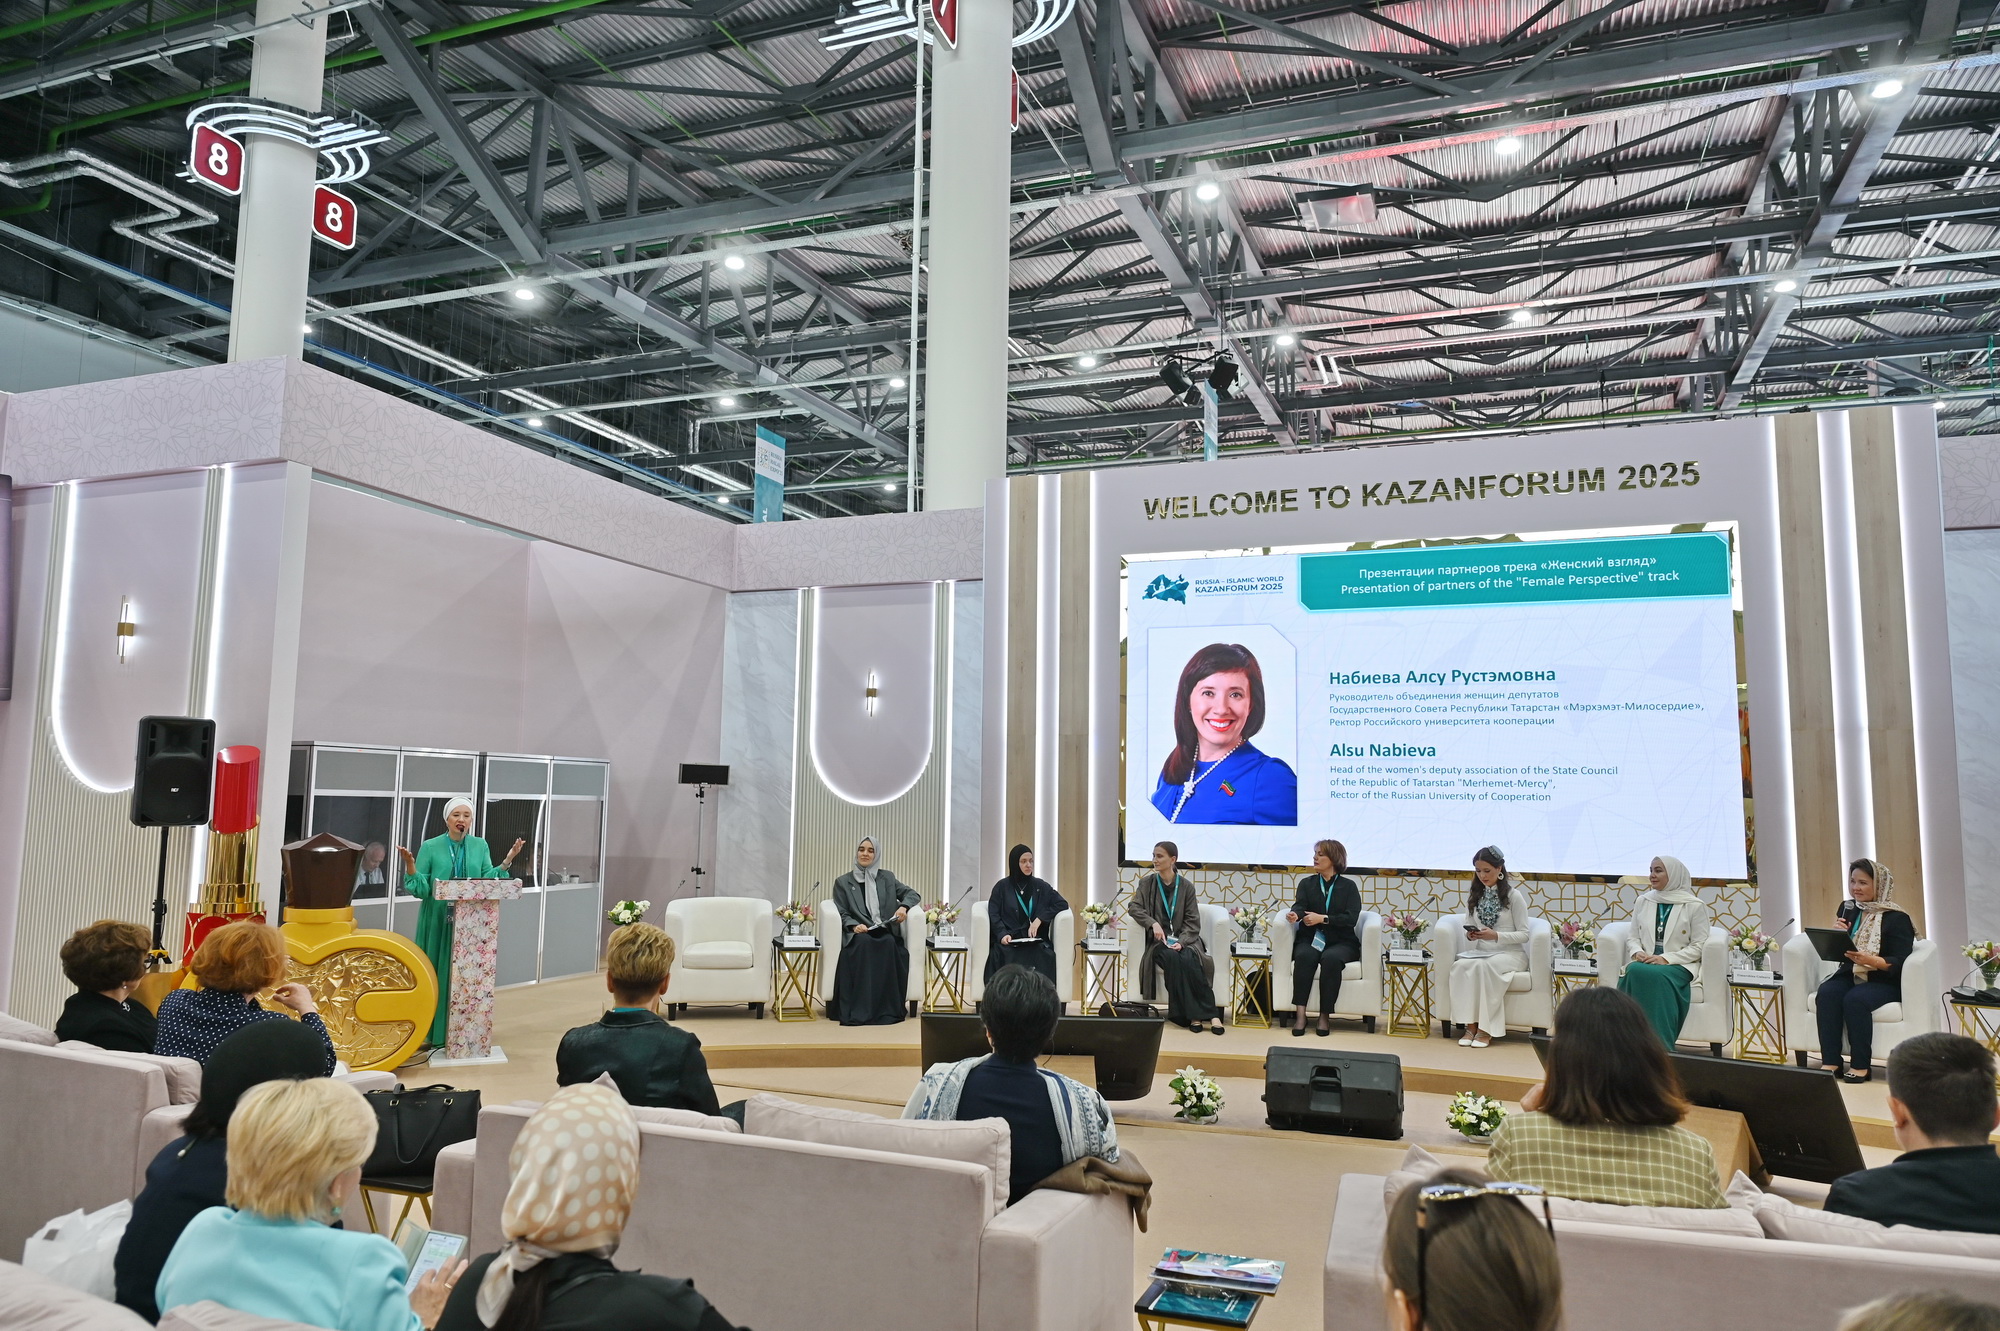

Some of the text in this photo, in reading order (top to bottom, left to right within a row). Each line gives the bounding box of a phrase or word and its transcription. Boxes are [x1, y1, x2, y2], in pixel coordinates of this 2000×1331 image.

[208, 142, 229, 176] 8
[325, 202, 343, 232] 8
[1143, 460, 1700, 520] WELCOME TO KAZANFORUM 2025
[1359, 556, 1656, 580] Презентации партнеров трека «Женский взгляд»
[1256, 575, 1284, 583] WORLD
[1341, 569, 1680, 594] Presentation of partners of the "Female Perspective" track
[1195, 584, 1258, 593] KAZANFORUM
[1330, 669, 1556, 686] Набиева Алсу Рустэмовна
[1329, 691, 1559, 702] Руководитель объединения женщин депутатов
[1329, 702, 1704, 715] Государственного Совета Республики Татарстан «Мэрхэмэт-Милосердие»,
[1329, 717, 1554, 728] Ректор Российского университета кооперации
[1329, 742, 1436, 757] Alsu Nabieva
[1330, 764, 1618, 776] Head of the women's deputy association of the State Council
[1329, 777, 1556, 790] of the Republic of Tatarstan "Merhemet-Mercy",
[1330, 790, 1551, 802] Rector of the Russian University of Cooperation
